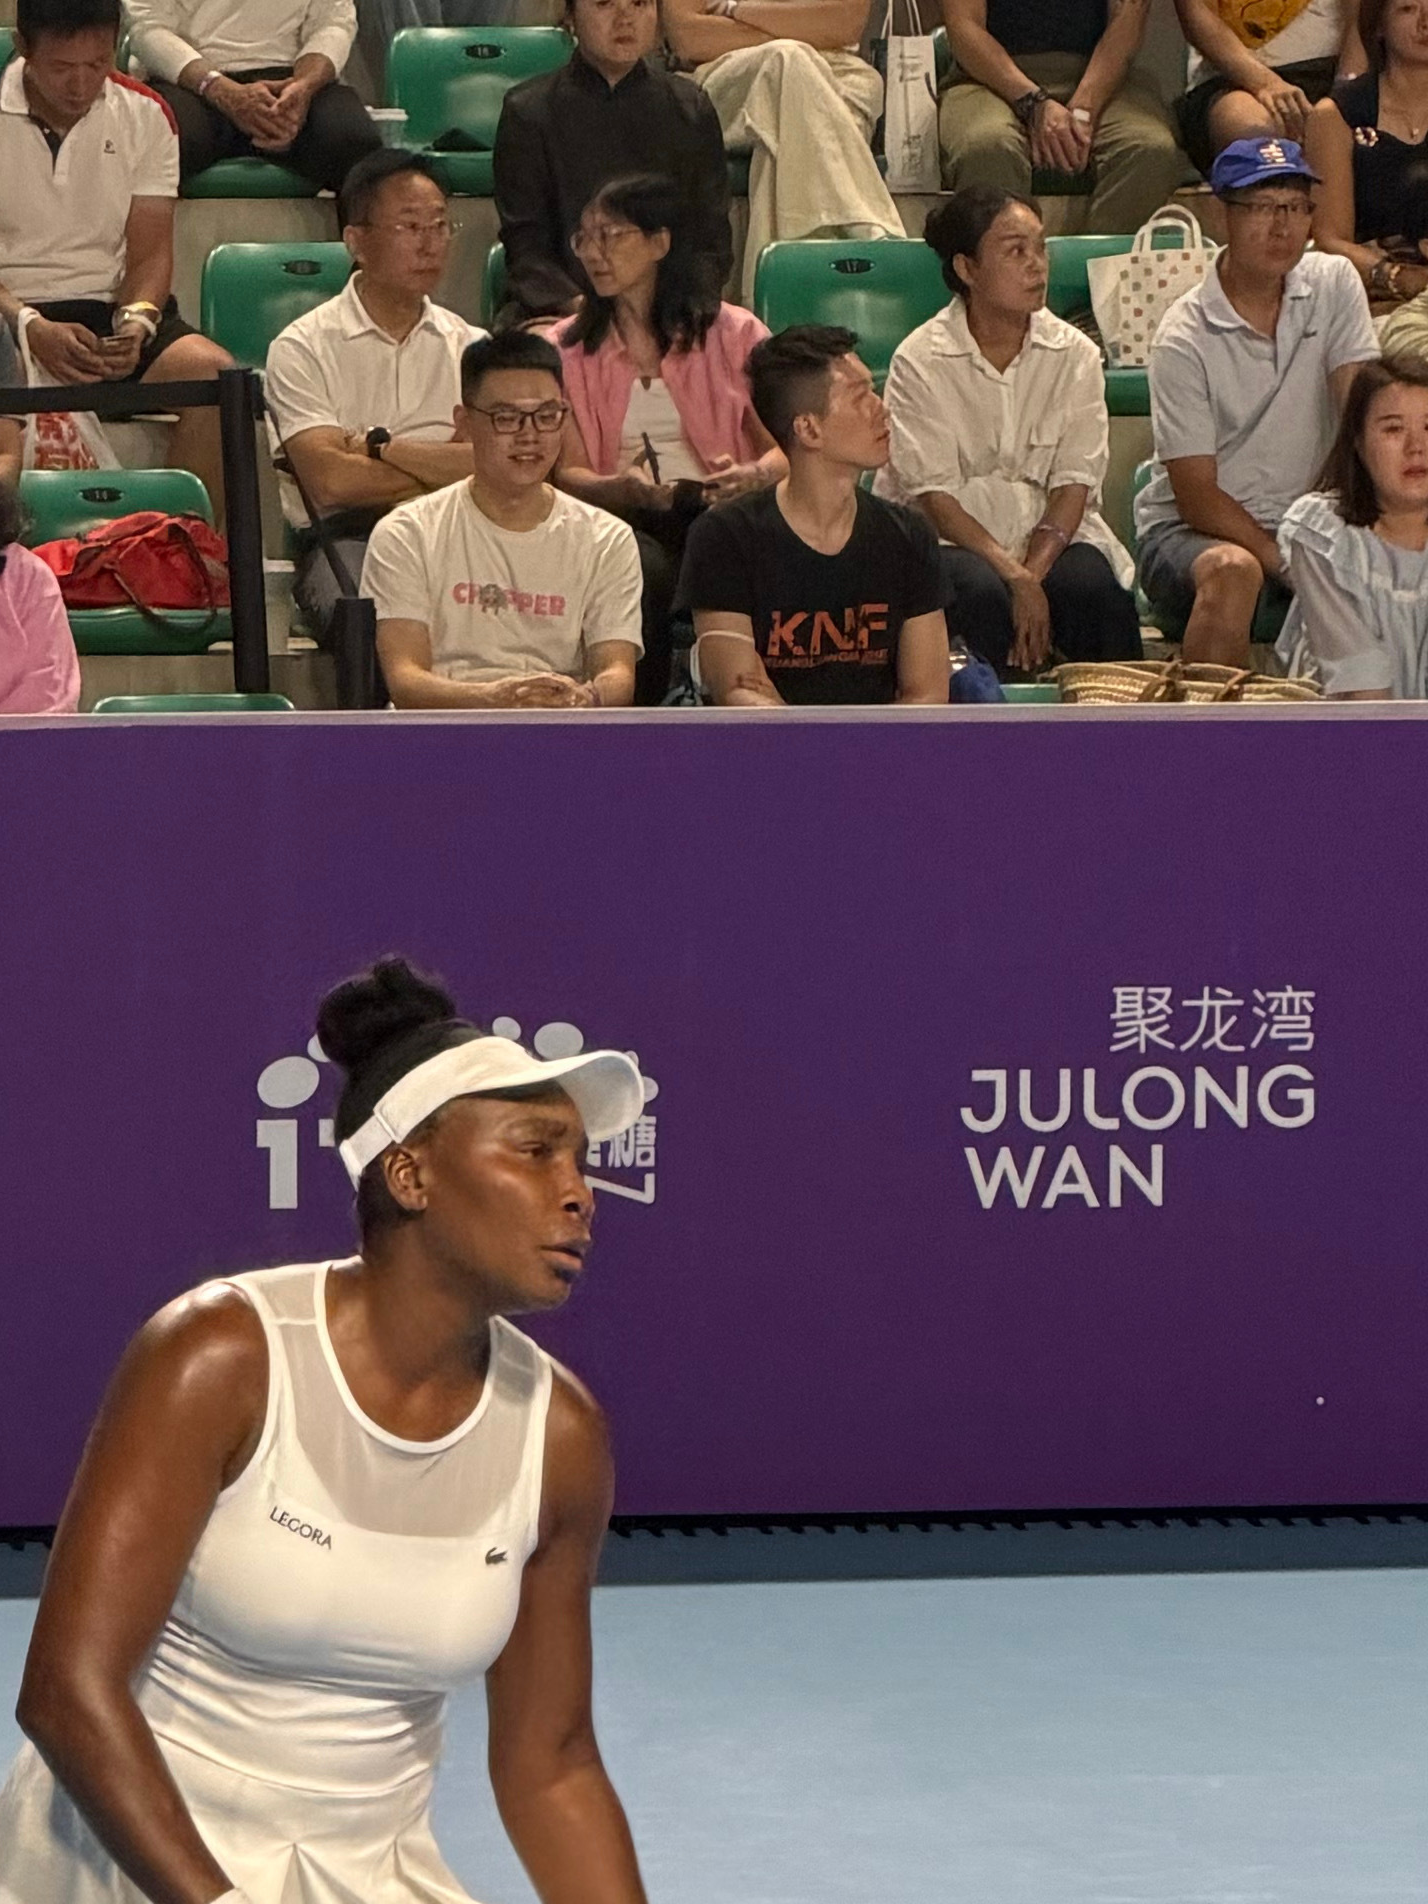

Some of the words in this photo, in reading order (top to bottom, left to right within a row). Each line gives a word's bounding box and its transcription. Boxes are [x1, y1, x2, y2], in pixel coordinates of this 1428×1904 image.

[767, 603, 889, 656] KNF
[1109, 984, 1316, 1054] 聚龙湾
[960, 1063, 1315, 1134] JULONG
[964, 1143, 1164, 1209] WAN
